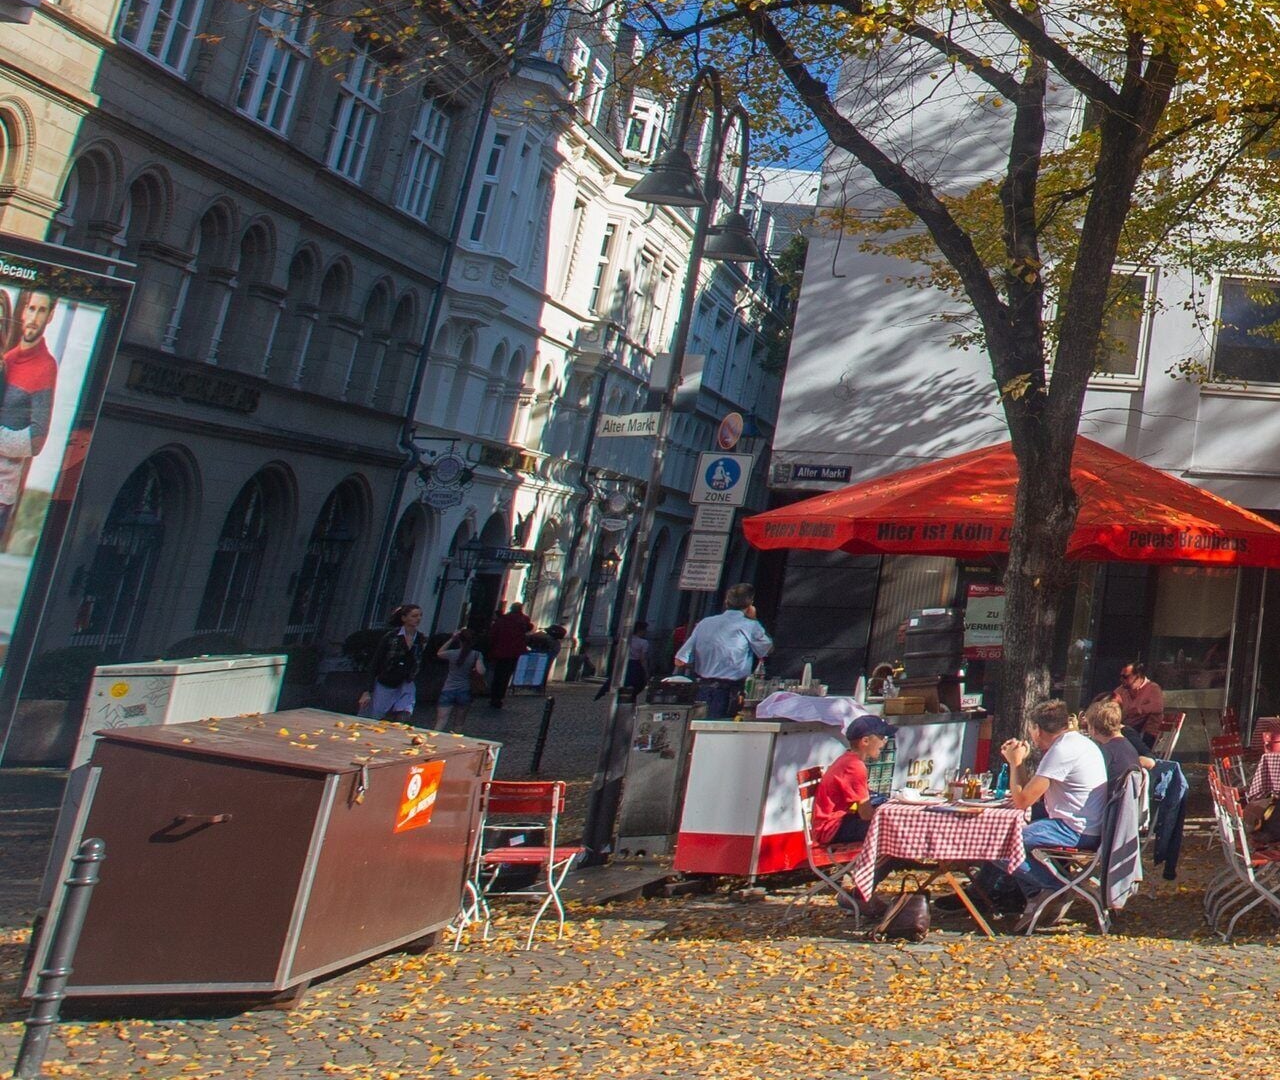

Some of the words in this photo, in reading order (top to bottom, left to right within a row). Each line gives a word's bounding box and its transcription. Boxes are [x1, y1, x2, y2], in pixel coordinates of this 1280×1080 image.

[602, 420, 625, 433] Alter
[627, 418, 655, 432] Markt
[797, 467, 817, 477] Alter
[821, 468, 846, 477] Markt
[705, 492, 732, 502] ZONE
[876, 522, 917, 540] Hier
[922, 523, 948, 539] ist
[952, 522, 992, 541] Köln
[1129, 530, 1176, 549] Peters
[986, 611, 999, 619] ZU
